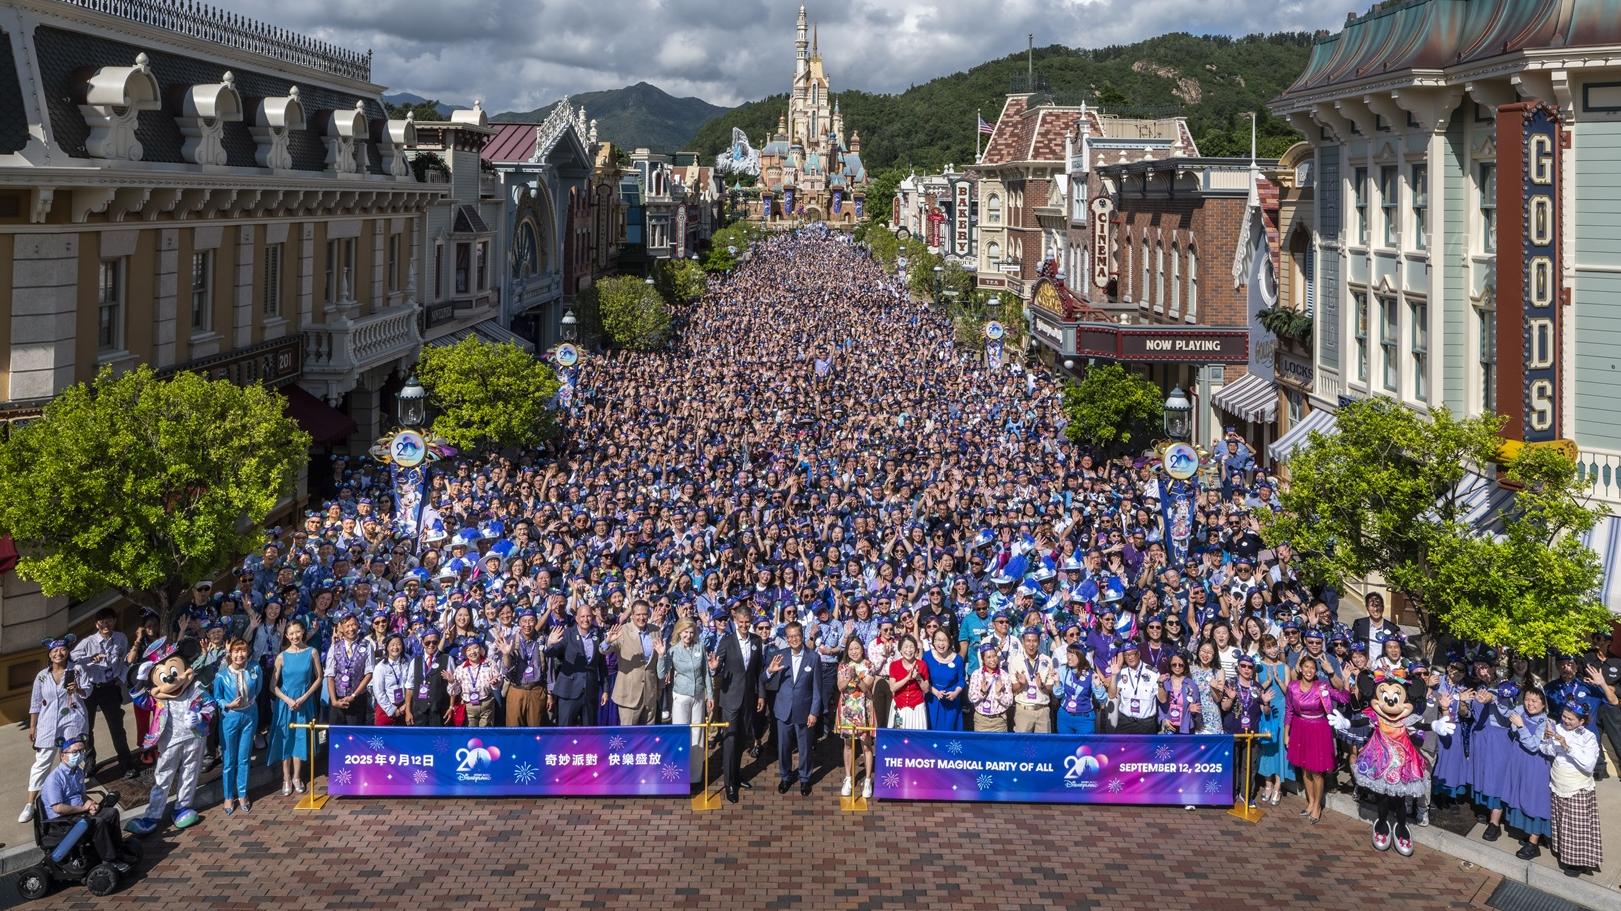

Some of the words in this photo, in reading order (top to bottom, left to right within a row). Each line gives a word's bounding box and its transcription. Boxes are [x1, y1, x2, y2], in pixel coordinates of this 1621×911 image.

[958, 187, 968, 252] BAKERY
[1096, 213, 1107, 278] CINEMA
[1528, 133, 1554, 431] GOODS
[1146, 339, 1172, 351] NOW
[1175, 340, 1221, 351] PLAYING
[279, 353, 292, 368] 201
[545, 753, 598, 766] 奇妙派對
[608, 752, 662, 766] 快樂盛放
[884, 757, 903, 768] THE
[905, 758, 936, 769] MOST
[937, 760, 984, 771] MAGICAL
[985, 761, 1018, 772] PARTY
[1019, 763, 1034, 772] OF
[1035, 763, 1054, 773] ALL
[1119, 762, 1177, 773] SEPTEMBER
[1178, 763, 1193, 774] 12,
[1194, 763, 1223, 773] 2025
